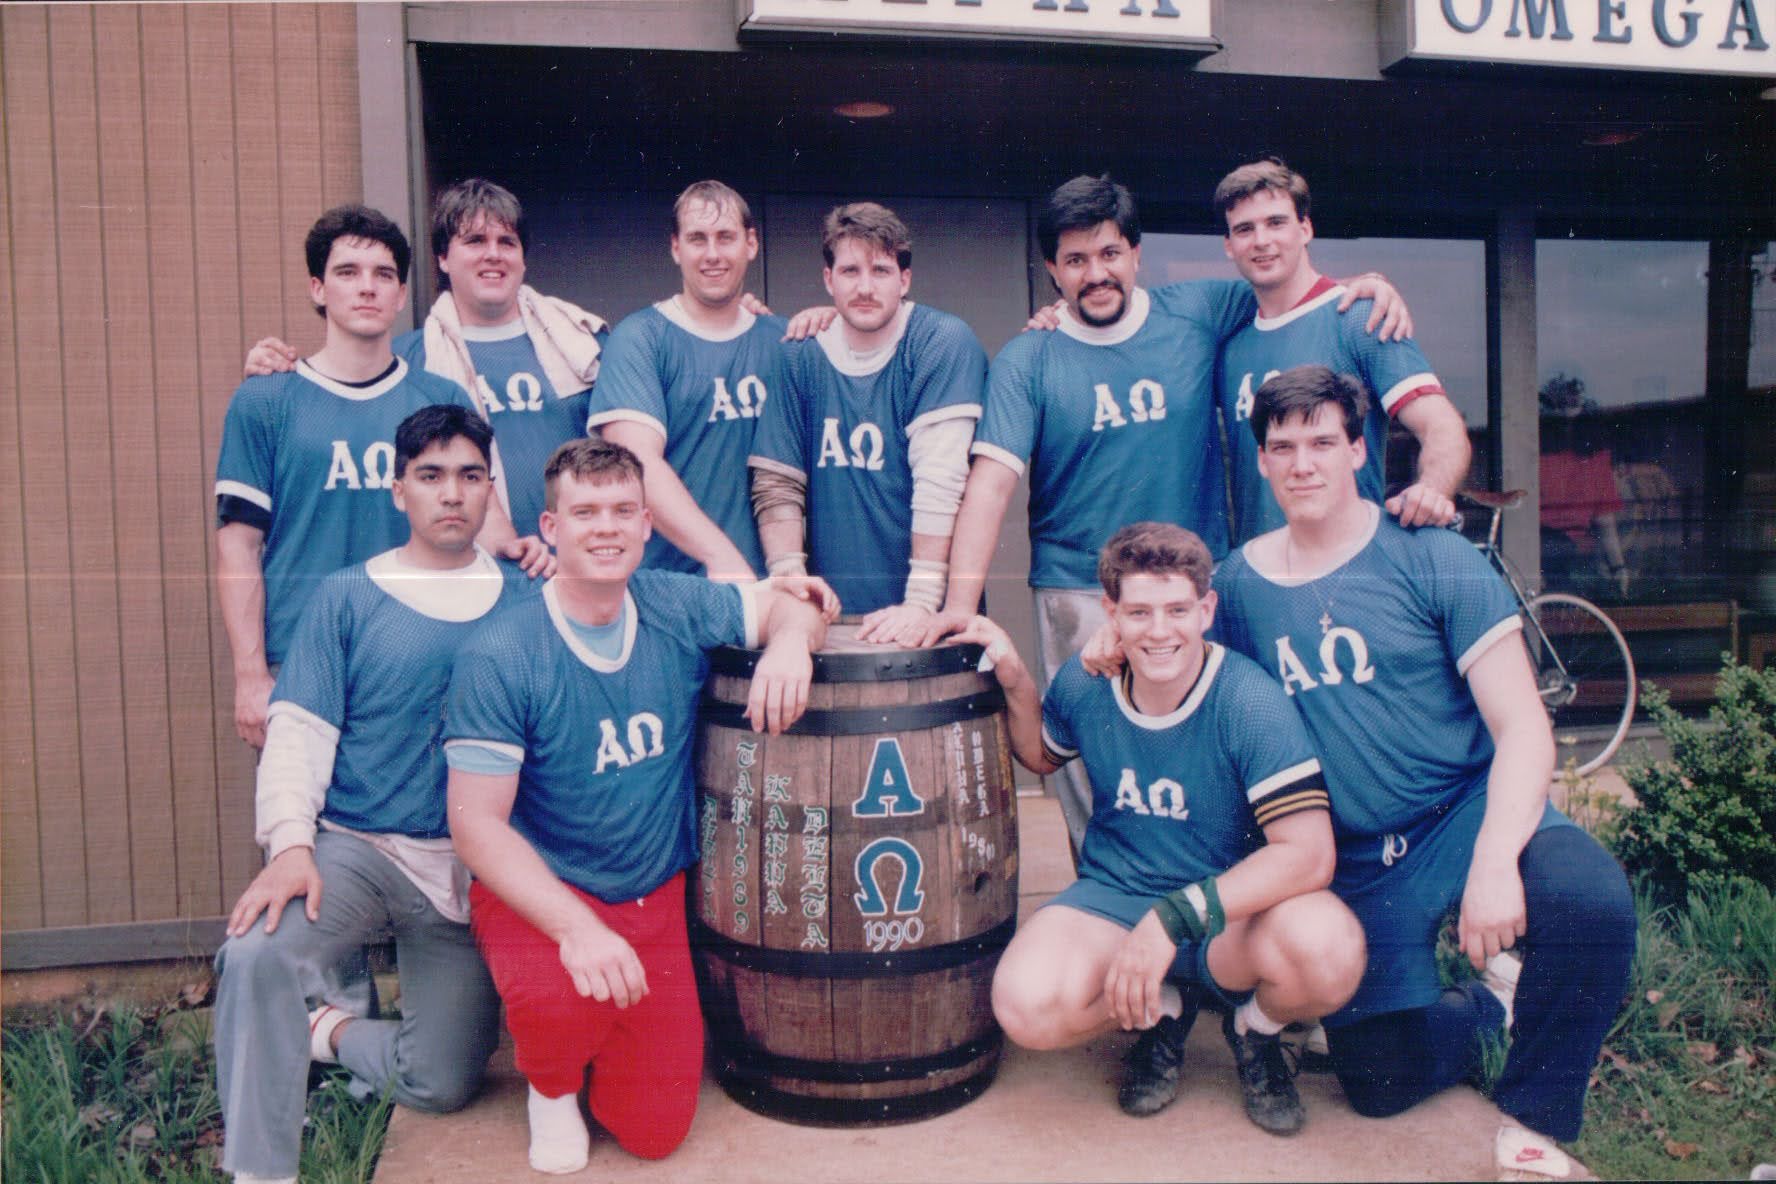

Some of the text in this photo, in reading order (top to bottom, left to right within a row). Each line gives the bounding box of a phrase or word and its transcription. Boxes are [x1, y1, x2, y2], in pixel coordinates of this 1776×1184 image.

[1440, 0, 1770, 52] OMEGA
[763, 773, 793, 915] KAPPA
[800, 804, 829, 949] DELTA
[863, 916, 926, 953] 1990
